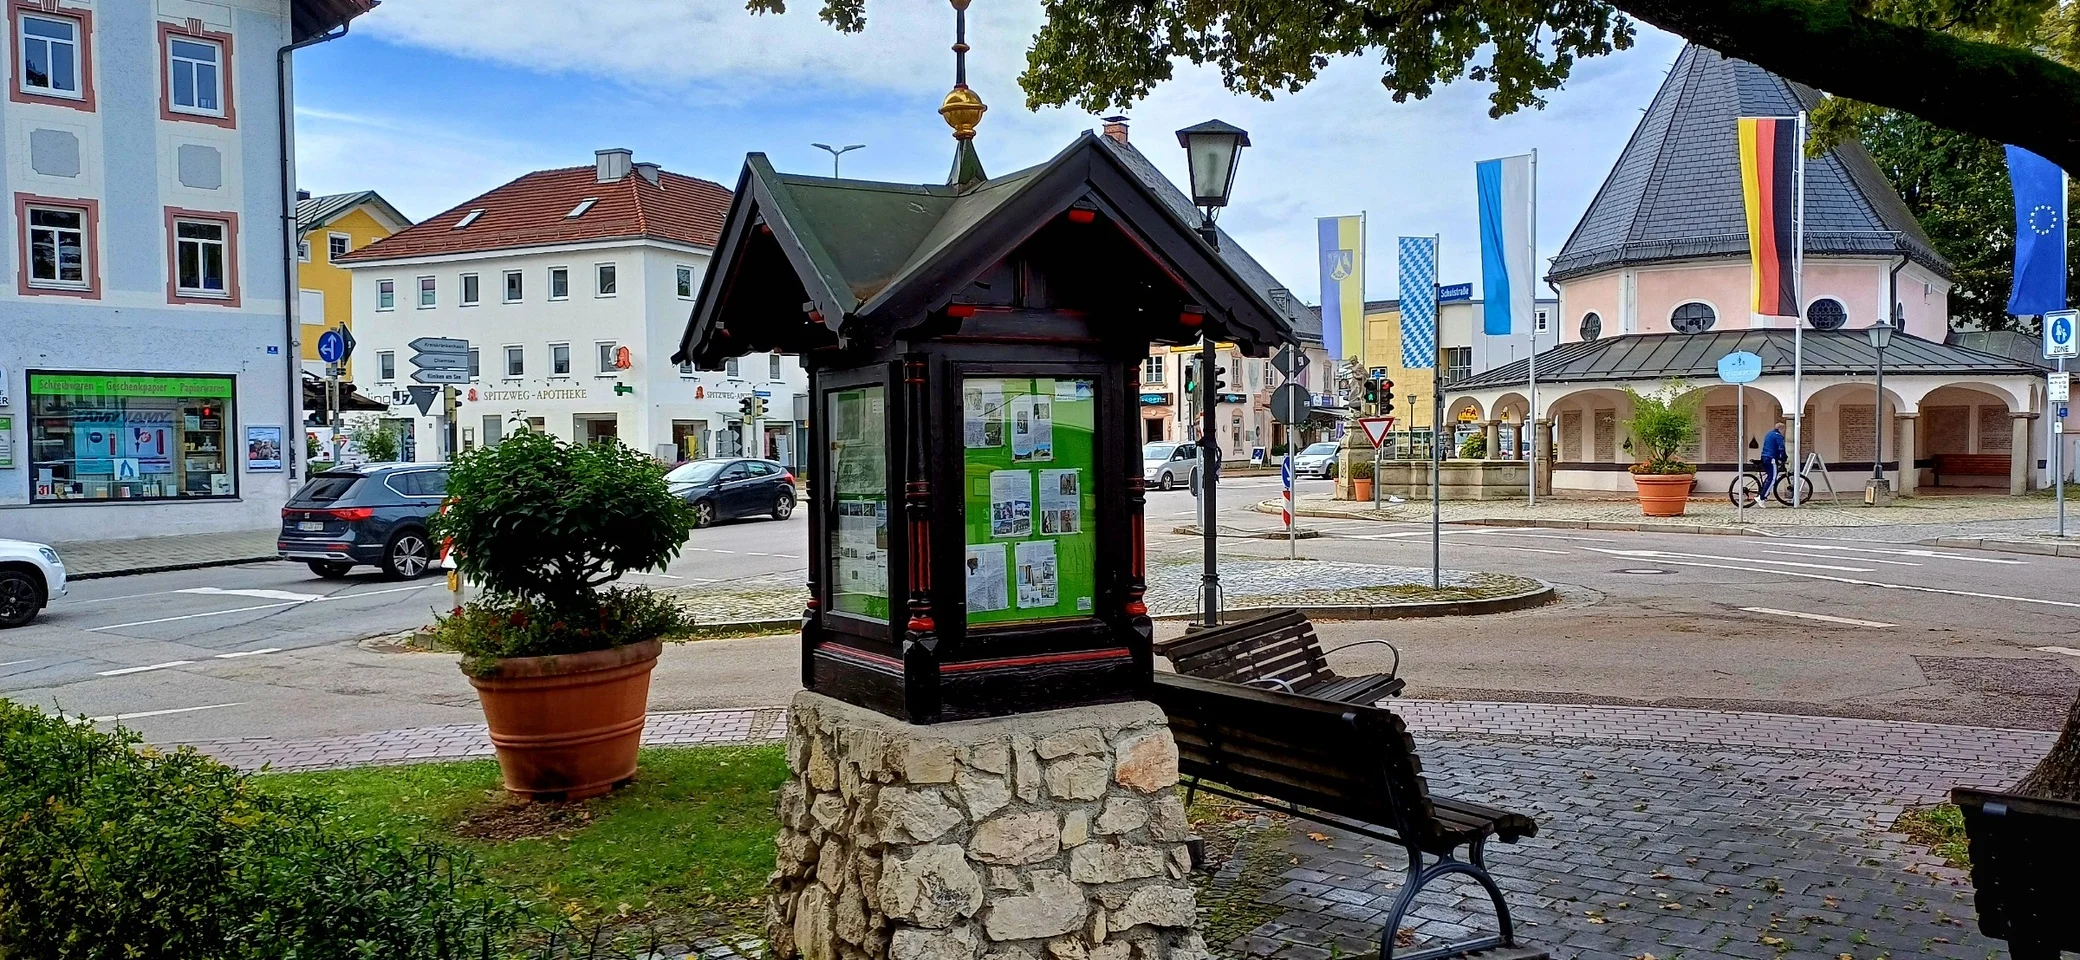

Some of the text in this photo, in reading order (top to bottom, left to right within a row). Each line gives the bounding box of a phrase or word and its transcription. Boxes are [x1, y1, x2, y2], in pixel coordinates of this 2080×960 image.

[1441, 286, 1469, 298] Schulstraße
[2053, 345, 2070, 353] ZONE
[39, 379, 95, 390] Schreibwaren
[106, 381, 167, 393] Geschenkpapier
[179, 382, 226, 393] Papierwaren
[38, 485, 50, 495] 31
